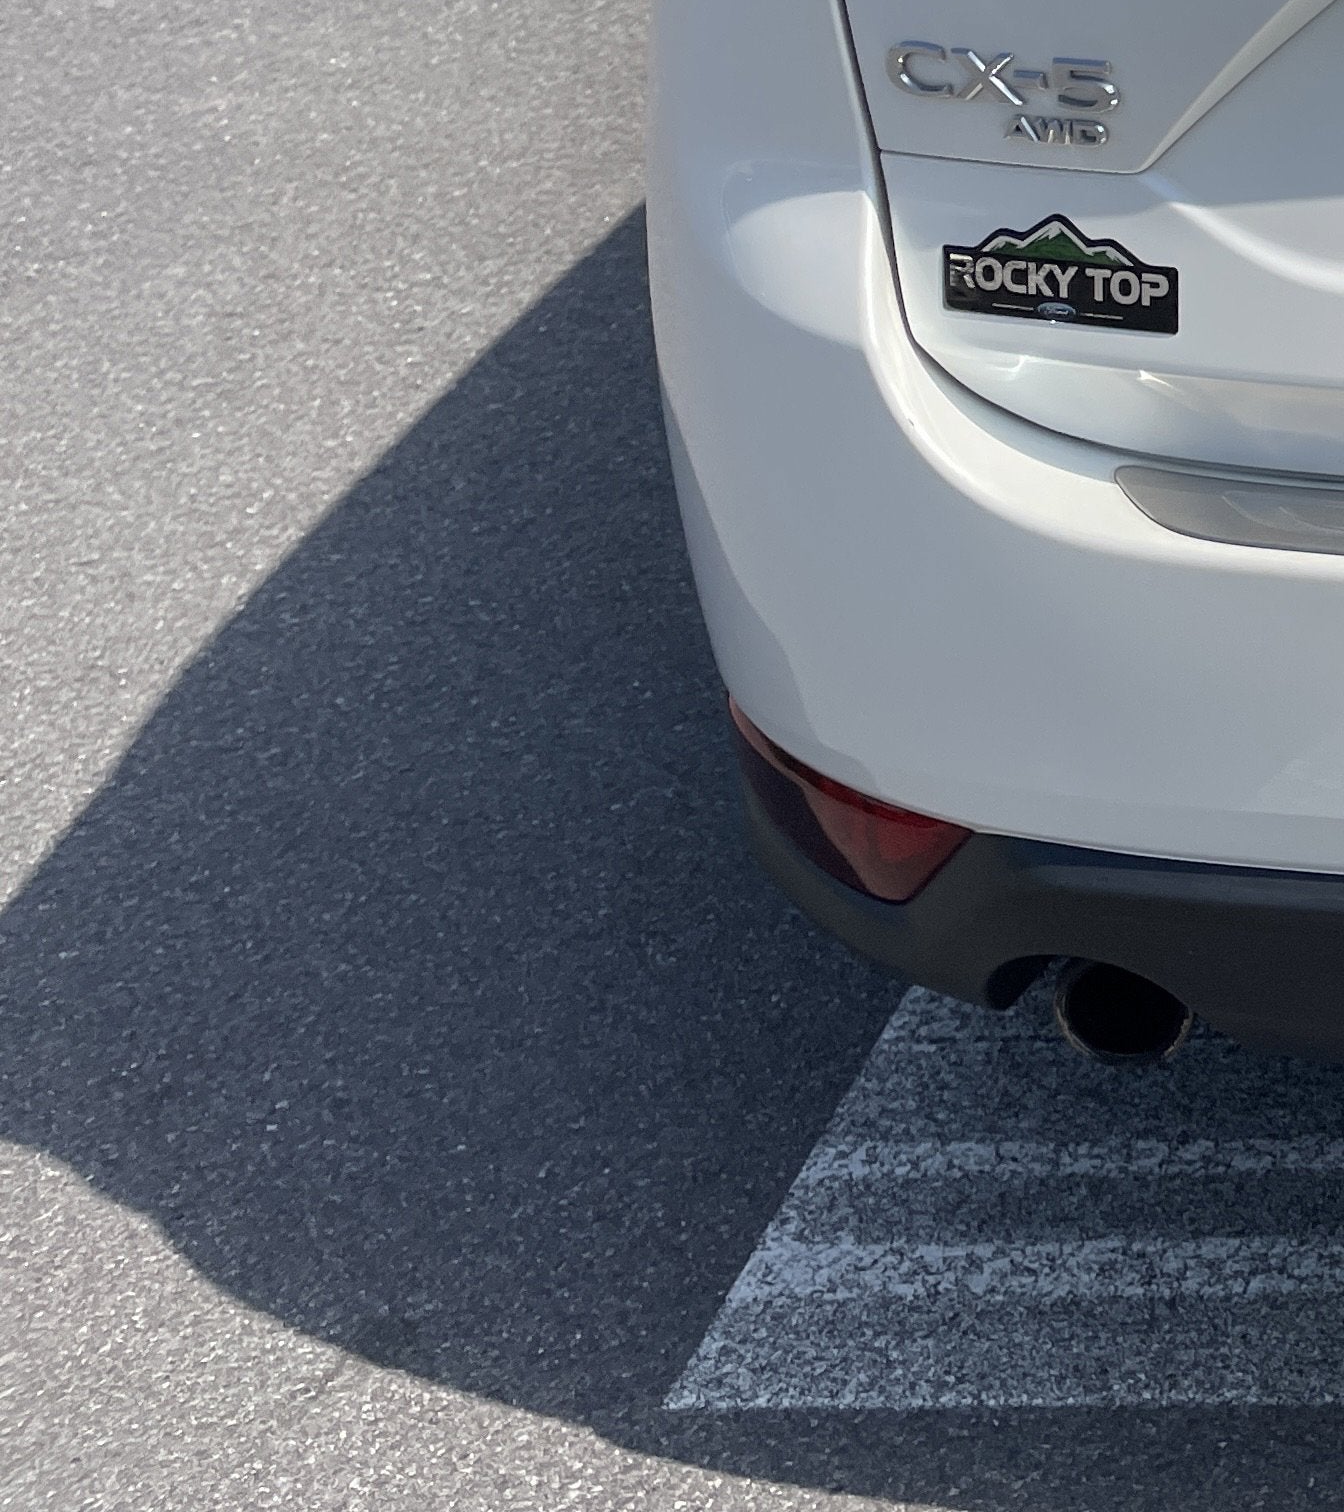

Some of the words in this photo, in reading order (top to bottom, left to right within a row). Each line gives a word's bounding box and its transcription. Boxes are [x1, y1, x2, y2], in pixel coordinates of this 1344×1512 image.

[885, 39, 1121, 114] CX-5
[1002, 113, 1110, 147] AWD
[949, 252, 1079, 299] ROCKY
[1085, 267, 1170, 307] TOP
